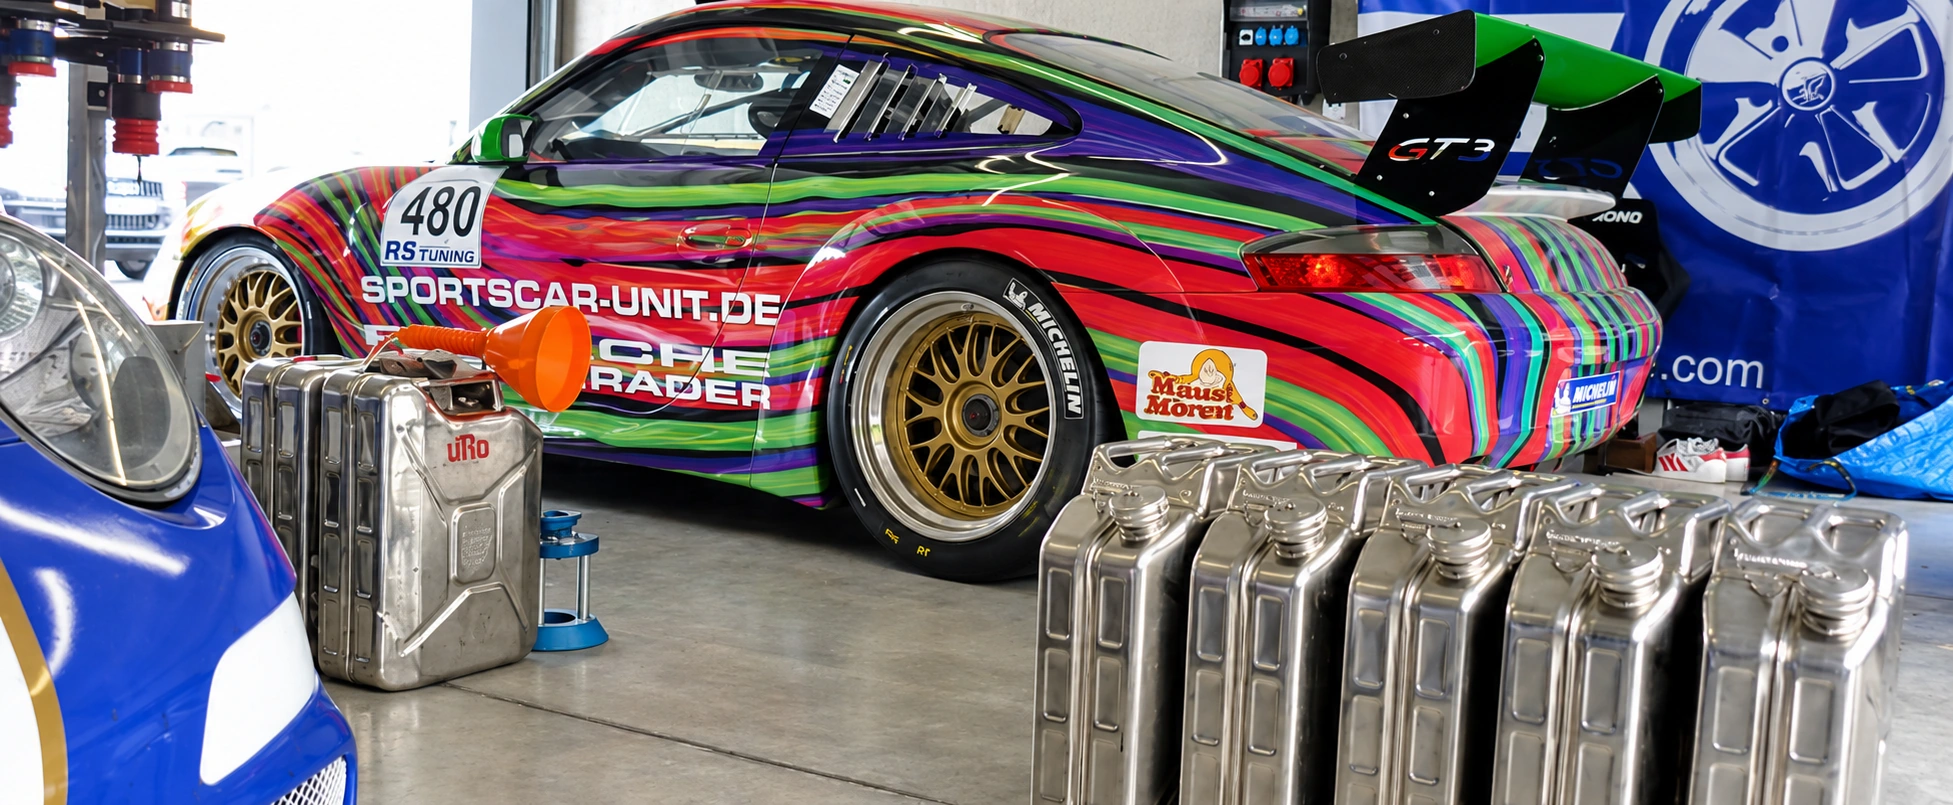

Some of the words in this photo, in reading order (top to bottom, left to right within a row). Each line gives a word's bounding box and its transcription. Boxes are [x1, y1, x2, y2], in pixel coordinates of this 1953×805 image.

[1388, 138, 1495, 162] GT3
[400, 186, 481, 237] 480
[384, 240, 417, 261] RS
[418, 249, 475, 263] TUNING
[360, 275, 780, 326] SPORTSCAR-UNIT.DE
[1026, 302, 1082, 415] MICHELIN
[1650, 354, 1764, 389] .com
[1572, 378, 1617, 403] MICHELIN
